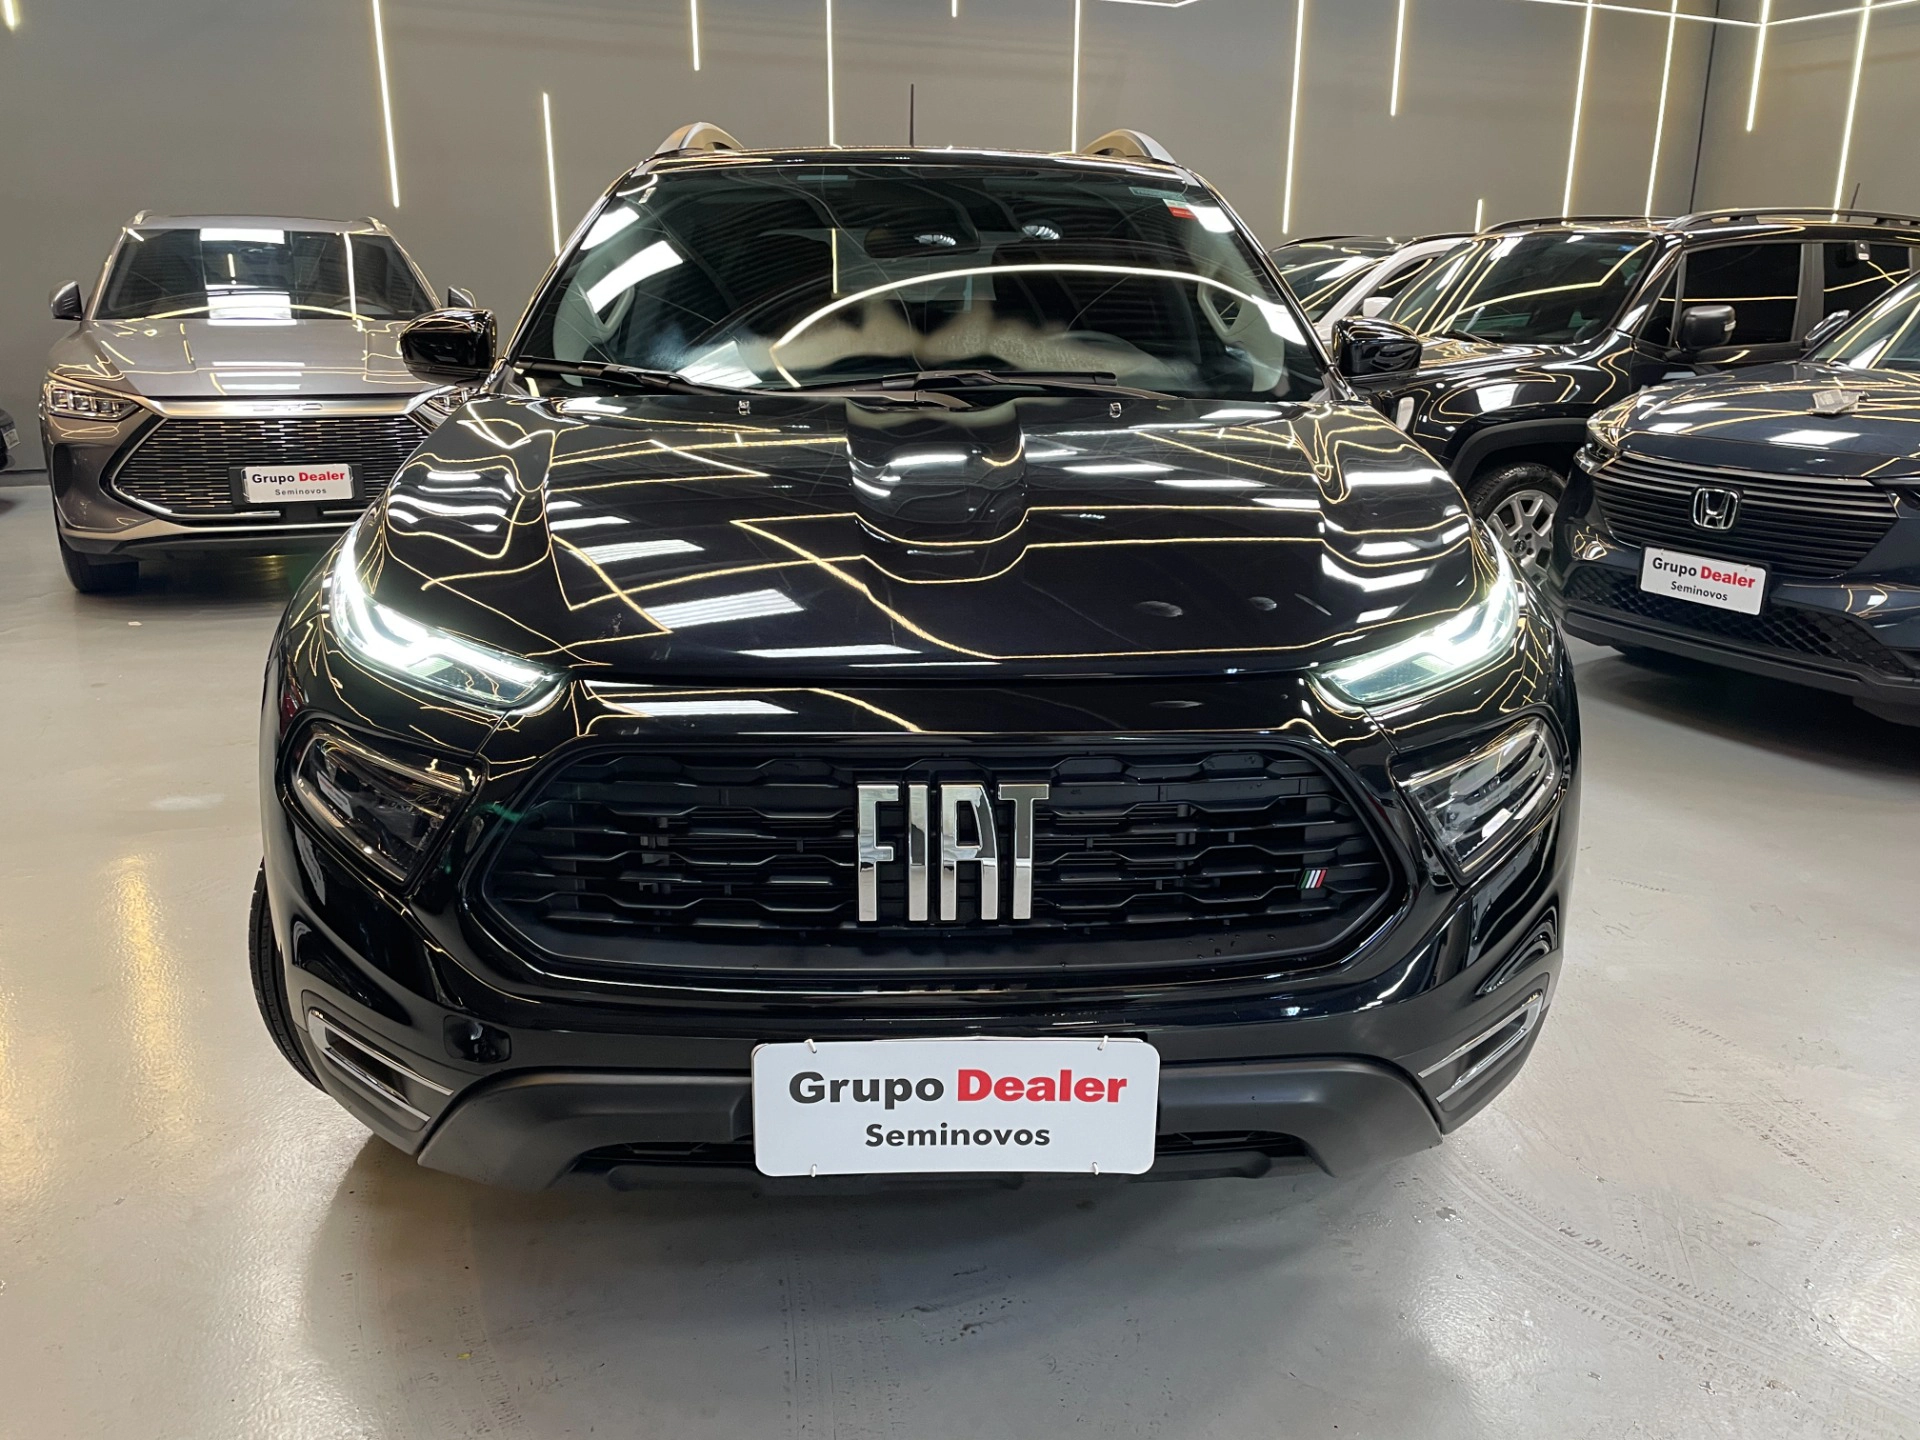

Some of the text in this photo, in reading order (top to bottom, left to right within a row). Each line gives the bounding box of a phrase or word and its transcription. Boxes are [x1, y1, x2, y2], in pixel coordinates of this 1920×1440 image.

[252, 471, 345, 485] Grupo Dealer
[275, 488, 327, 496] Seminovos
[1652, 557, 1756, 588] Grupo Dealer
[1670, 581, 1728, 601] Seminovos
[857, 784, 1050, 921] FIAT
[789, 1069, 1128, 1110] Grupo Dealer
[865, 1122, 1051, 1147] Seminovos
